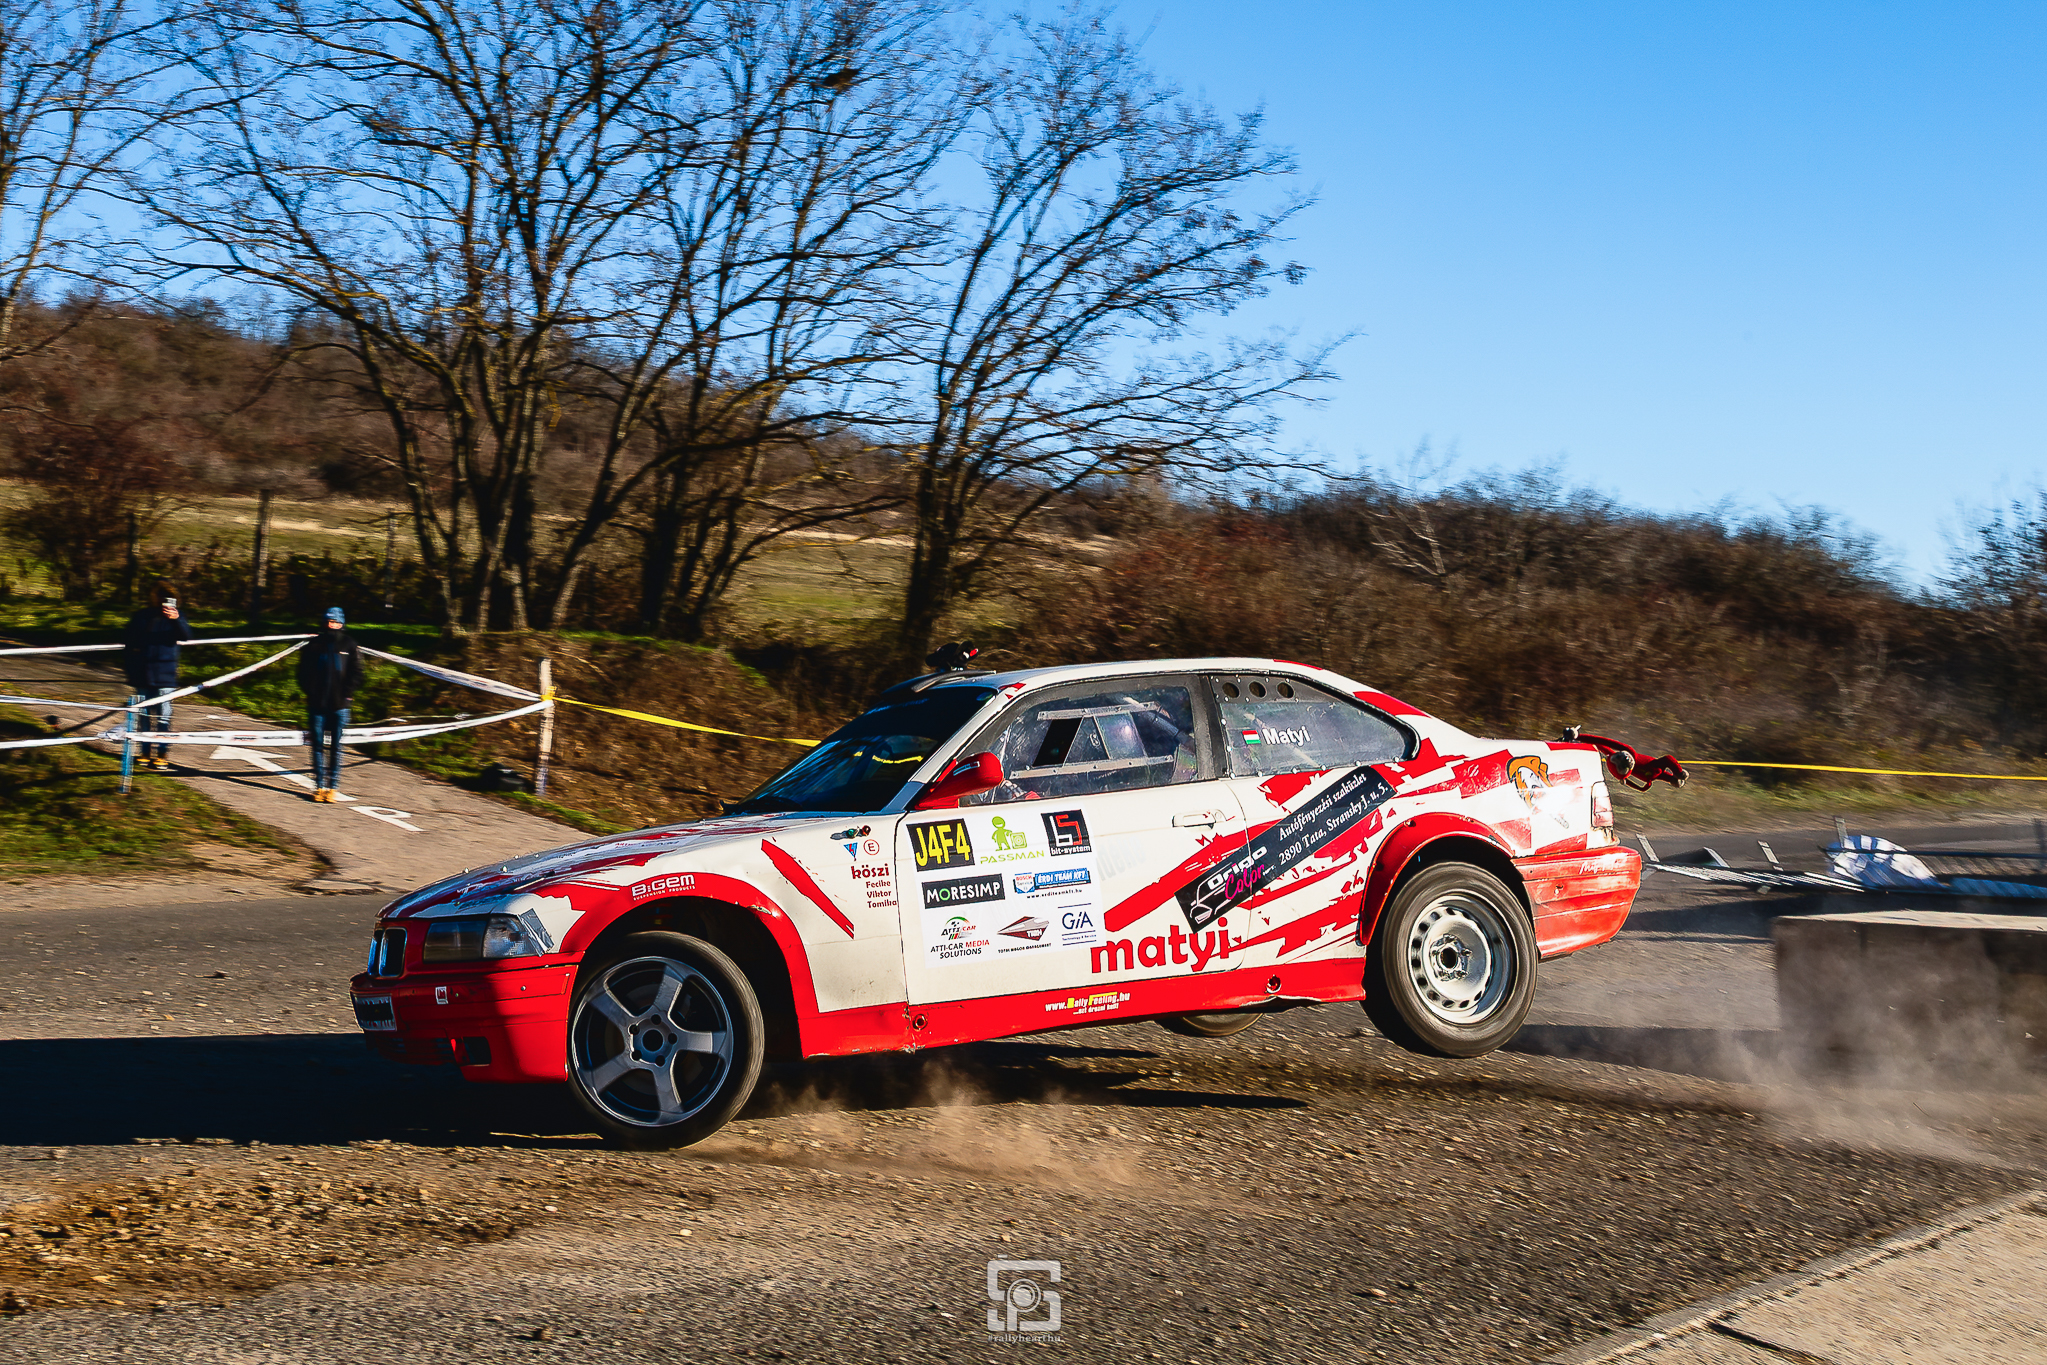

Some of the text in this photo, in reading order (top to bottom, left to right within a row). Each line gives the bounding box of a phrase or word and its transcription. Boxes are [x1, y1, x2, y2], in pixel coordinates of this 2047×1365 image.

[1262, 725, 1311, 746] Matyi
[1279, 773, 1368, 842] Autófényezési szaküzlet
[915, 822, 972, 867] J4F4
[1278, 841, 1303, 866] 2890
[1302, 827, 1328, 849] Tata,
[1326, 801, 1363, 833] Stransky
[851, 863, 890, 880] köszi
[980, 849, 1045, 865] PASSMAN
[1207, 845, 1268, 891] Origo
[927, 881, 1001, 904] MORESIMP
[1224, 863, 1265, 900] Color
[930, 939, 990, 953] ATTI-CAR MEDIA
[939, 947, 982, 959] SOLUTIONS
[1090, 917, 1230, 973] matyi
